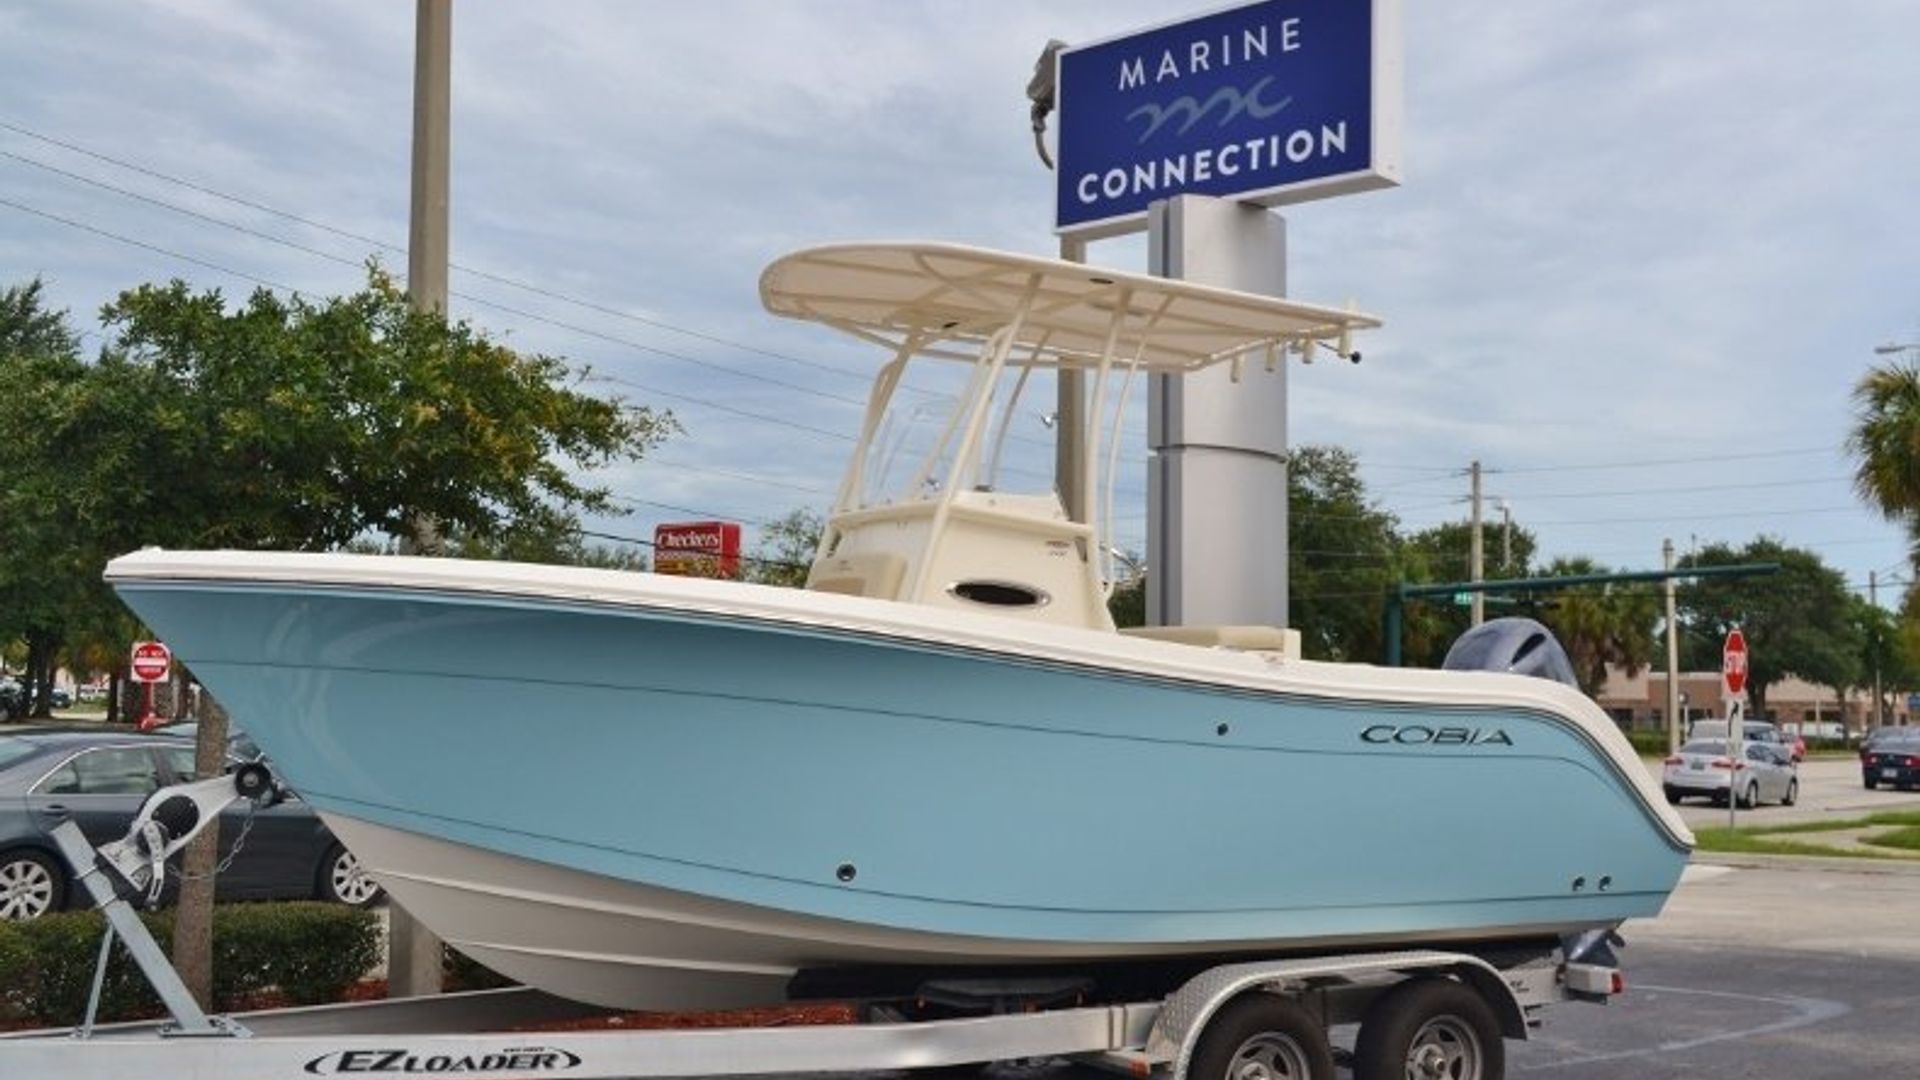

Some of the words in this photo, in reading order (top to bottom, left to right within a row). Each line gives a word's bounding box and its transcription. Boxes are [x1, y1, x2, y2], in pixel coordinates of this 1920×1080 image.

[1118, 17, 1300, 90] MARINE
[1077, 121, 1346, 203] CONNECTION
[1360, 725, 1514, 746] COBIA
